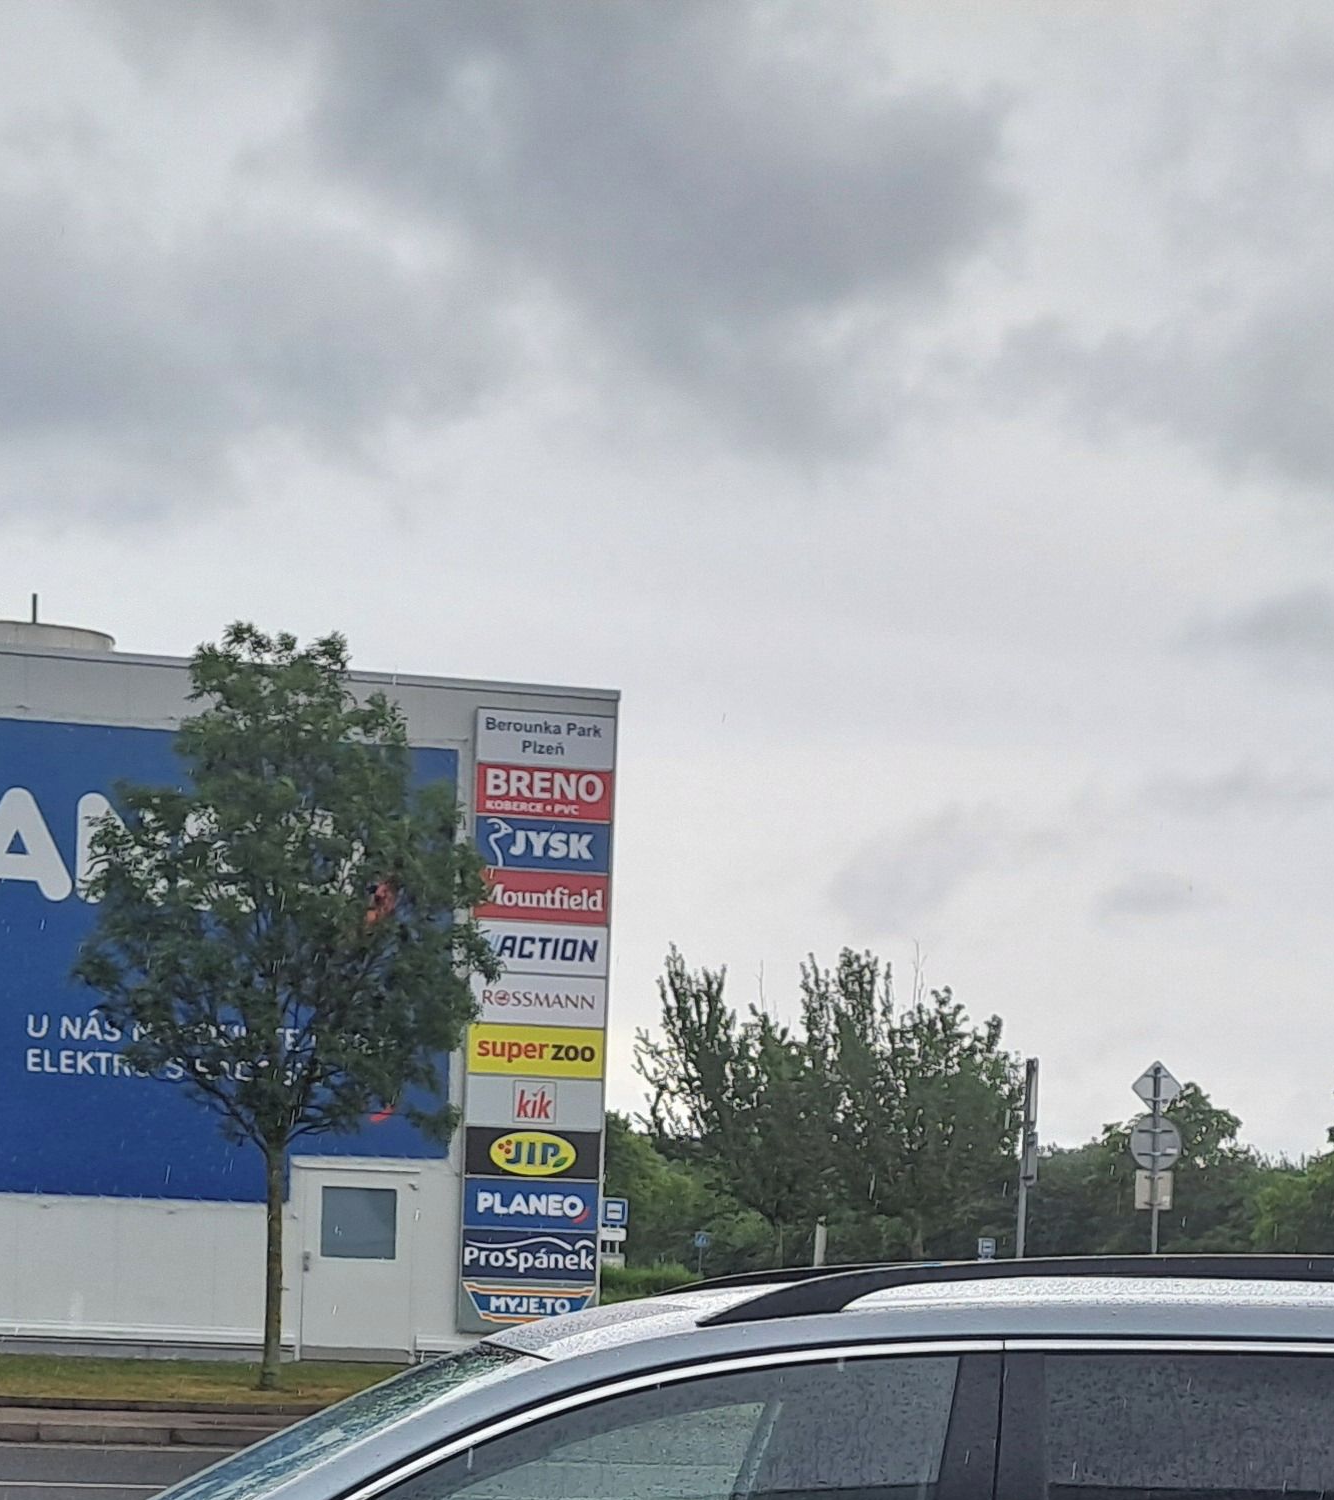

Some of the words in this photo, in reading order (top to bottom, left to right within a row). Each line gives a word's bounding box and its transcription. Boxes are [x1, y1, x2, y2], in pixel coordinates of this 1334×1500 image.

[486, 717, 562, 735] Berounka
[567, 723, 603, 738] Park
[522, 740, 565, 755] Plzeň
[486, 768, 605, 803] BRENO
[486, 800, 544, 813] KOBERCE
[554, 804, 580, 815] PVC
[509, 830, 593, 860] JYSK
[488, 884, 604, 912] Mountfield
[497, 935, 599, 963] ACTION
[482, 990, 595, 1011] ROSSMANN
[26, 1013, 49, 1039] U
[60, 1009, 122, 1042] NÁS
[26, 1048, 150, 1078] ELEKTR
[505, 1142, 560, 1167] JIP
[476, 1191, 585, 1219] PLANEO
[464, 1246, 594, 1273] ProSpánek
[489, 1296, 570, 1315] MYJE.TO
